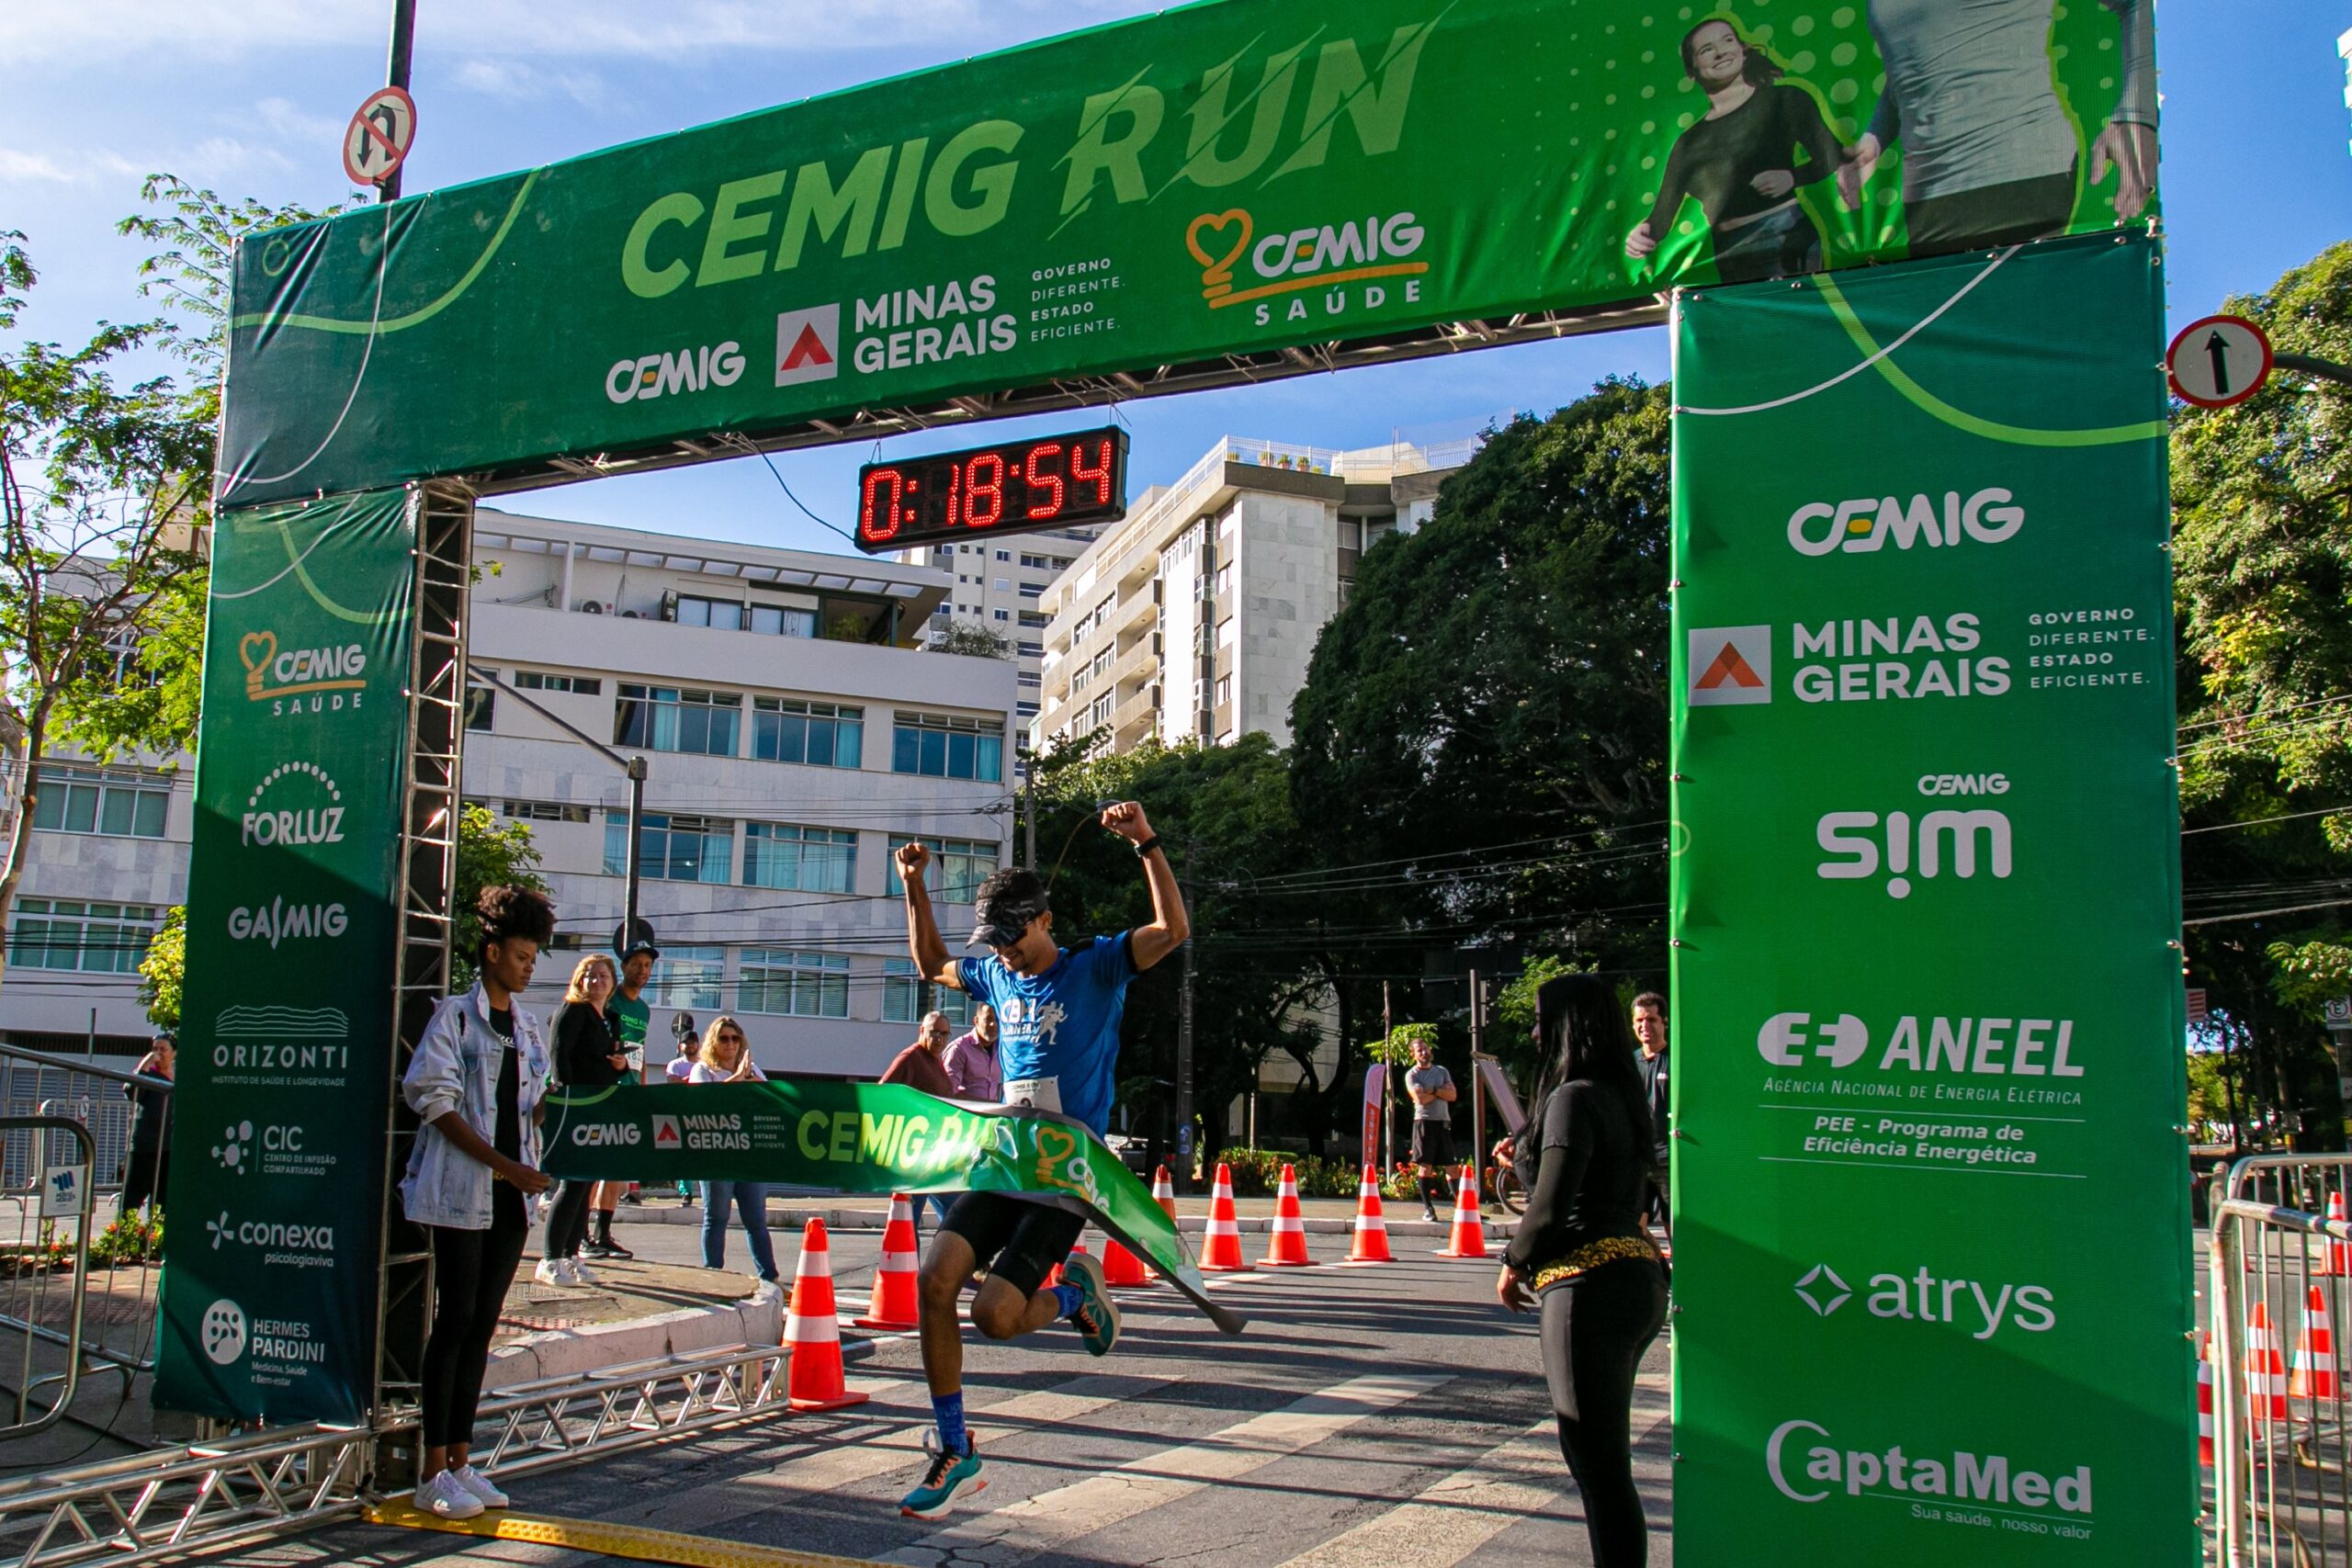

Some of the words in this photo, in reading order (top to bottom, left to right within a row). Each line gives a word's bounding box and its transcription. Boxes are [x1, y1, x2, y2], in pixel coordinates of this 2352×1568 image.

[621, 119, 1025, 299] CEMIG
[1055, 13, 1447, 230] RUN
[1252, 210, 1425, 279] CEMIG
[1032, 257, 1112, 282] GOVERNO
[1032, 276, 1125, 302] DIFERENTE.
[854, 275, 997, 333] MINAS
[1031, 301, 1094, 322] ESTADO
[1255, 280, 1420, 326] SAÚDE
[1031, 318, 1121, 343] EFICIENTE.
[854, 314, 1018, 375] GERAIS
[605, 341, 746, 404] CEMIG
[861, 440, 1112, 541] 0:18:54
[1786, 487, 2025, 557] CEMIG
[2029, 608, 2135, 626] GOVERNO
[1792, 613, 1981, 660] MINAS
[2029, 628, 2156, 647] DIFERENTE.
[275, 644, 367, 683] CEMIG
[2030, 651, 2115, 668] ESTADO
[1792, 657, 2011, 704] GERAIS
[2030, 671, 2152, 688] EFICIENTE.
[273, 692, 362, 716] SAÚDE
[1917, 773, 2010, 795] CEMIG
[242, 807, 345, 847] FORLUZ
[229, 894, 348, 950] GASMIG
[213, 1044, 348, 1069] ORIZONTI
[1879, 1015, 2085, 1077] ANEEL
[211, 1076, 248, 1085] INSTITUTO
[249, 1077, 259, 1085] DE
[261, 1075, 285, 1086] SAÚDE
[287, 1077, 291, 1086] E
[292, 1077, 345, 1088] LONGEVIDADE
[571, 1122, 641, 1146] CEMIG
[683, 1113, 741, 1131] MINAS
[1814, 1115, 1856, 1133] PEE
[1877, 1118, 1988, 1140] Programa
[1996, 1123, 2025, 1142] de
[264, 1125, 303, 1152] CIC
[687, 1132, 751, 1150] GERAIS
[797, 1109, 926, 1170] CEMIG
[1804, 1136, 1907, 1158] Eficiência
[1915, 1142, 2038, 1165] Energética
[263, 1165, 325, 1176] COMPARTILHADO
[264, 1154, 292, 1163] CENTRO
[294, 1155, 303, 1164] DE
[304, 1154, 336, 1165] INFUSÃO
[239, 1221, 334, 1250] conexa
[265, 1252, 334, 1268] psicologiaviva
[1867, 1266, 2056, 1340] atrys
[254, 1318, 310, 1338] HERMES
[252, 1337, 325, 1362] PARDINI
[1766, 1419, 2093, 1514] CaptaMed
[1911, 1504, 1941, 1521] Sua
[1945, 1509, 1996, 1529] saúde,
[2001, 1517, 2048, 1535] nosso
[2052, 1524, 2093, 1540] valor
